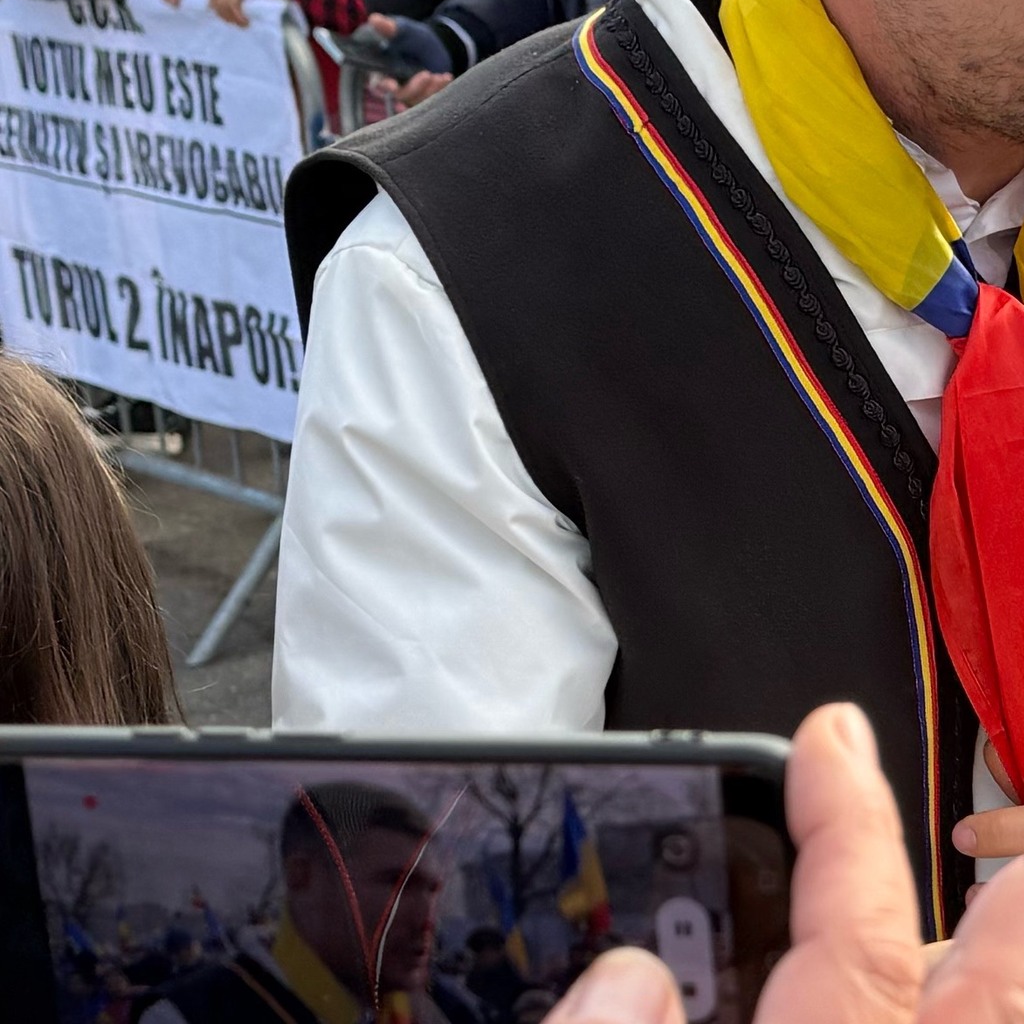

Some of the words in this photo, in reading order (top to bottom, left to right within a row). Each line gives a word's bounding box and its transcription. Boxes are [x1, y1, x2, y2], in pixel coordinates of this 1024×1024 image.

[12, 33, 91, 102] VOTUL
[94, 45, 155, 112] MEU
[161, 55, 224, 125] ESTE
[12, 246, 119, 344] TURUL
[117, 274, 151, 352] 2
